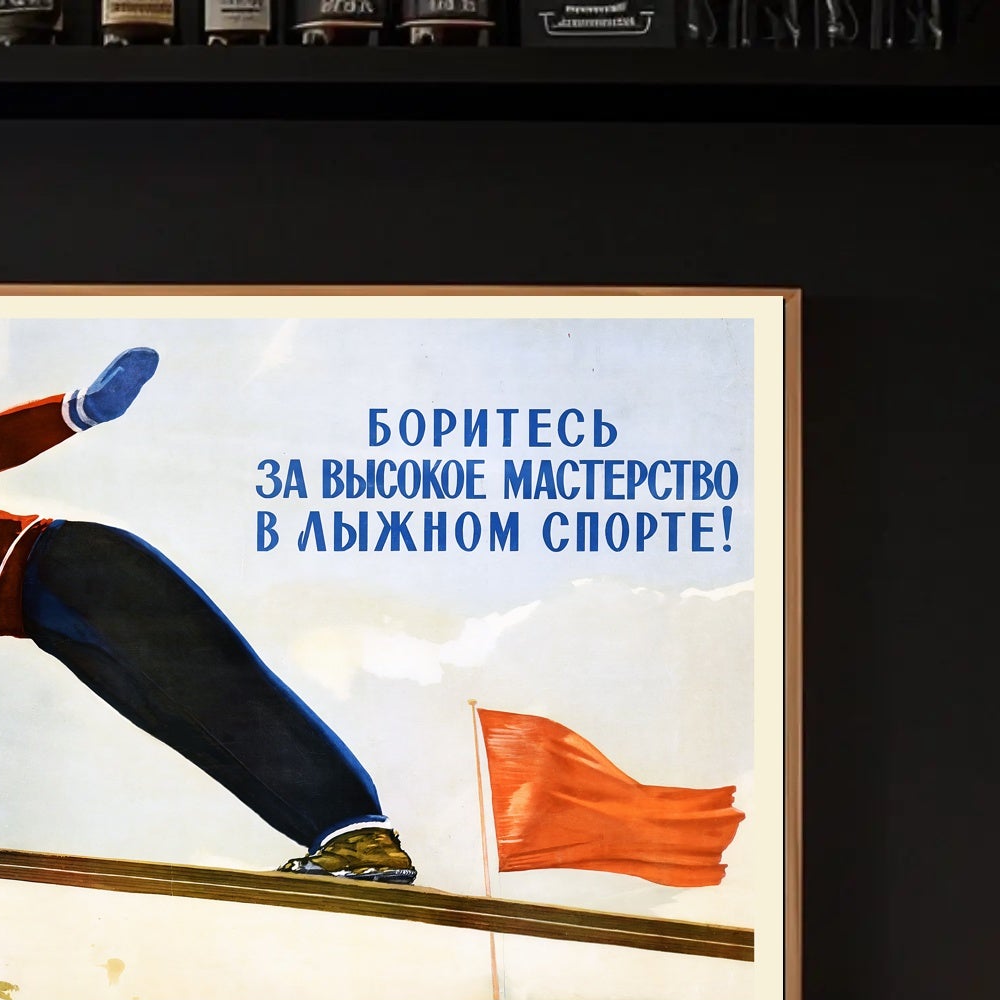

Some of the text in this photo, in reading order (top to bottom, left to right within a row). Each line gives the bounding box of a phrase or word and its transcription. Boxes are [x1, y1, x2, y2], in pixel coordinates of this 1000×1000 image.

[368, 407, 618, 448] БОРИТЕСЬ
[255, 458, 739, 500] ЗА ВЫСОКОЕ МАСТЕРСТВО
[256, 505, 733, 553] В ЛЫЖНОМ СПОРТЕ!
